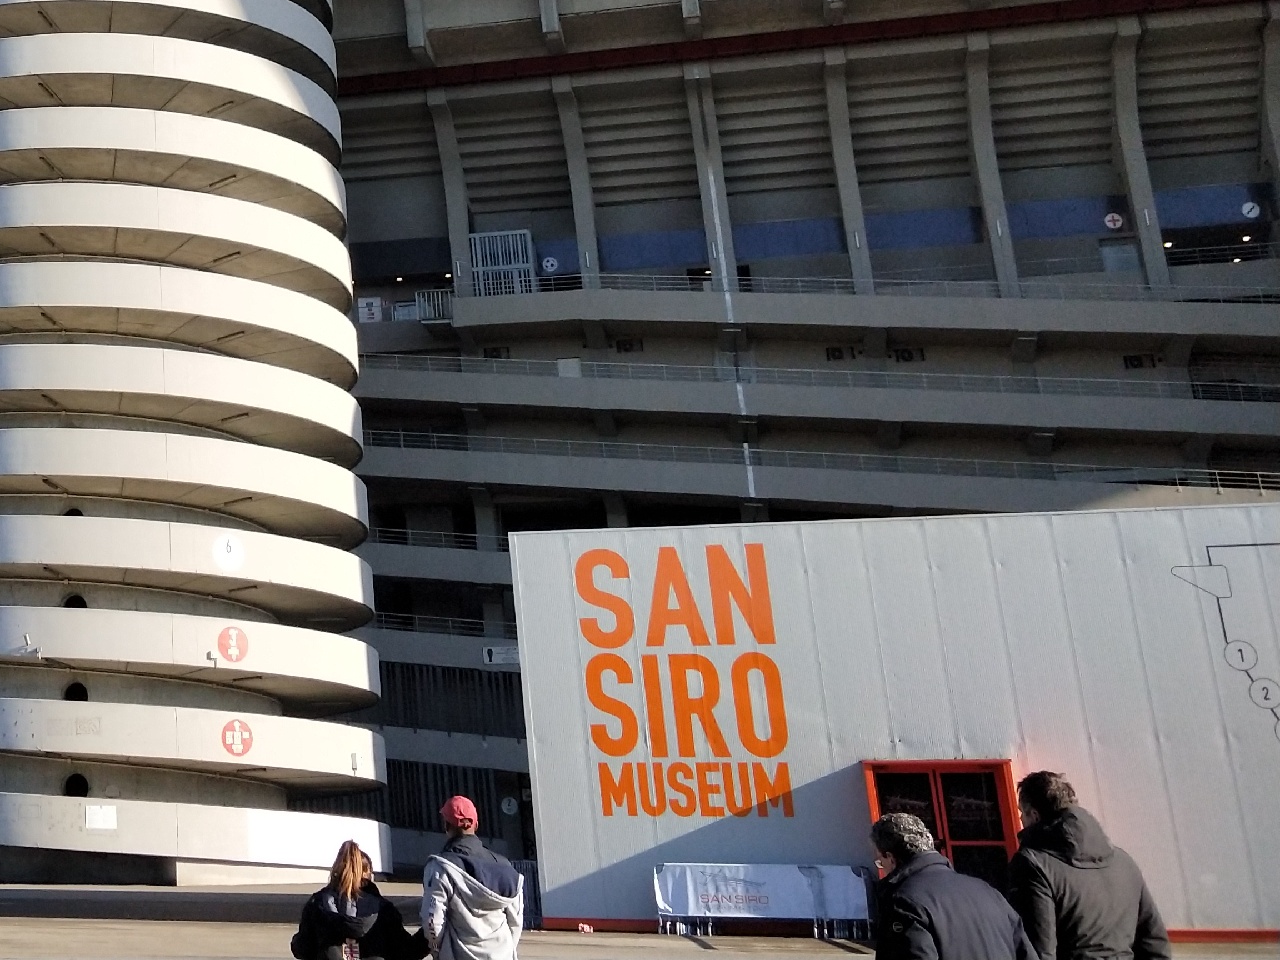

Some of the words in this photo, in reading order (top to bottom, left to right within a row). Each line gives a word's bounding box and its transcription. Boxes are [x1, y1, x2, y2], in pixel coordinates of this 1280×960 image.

[226, 538, 232, 554] 6
[574, 543, 776, 649] SAN
[1237, 648, 1245, 663] 1
[1262, 686, 1271, 701] 2
[585, 651, 788, 758] SIRO
[597, 761, 795, 818] MUSEUM
[700, 894, 732, 904] SAN
[734, 895, 769, 905] SIRO
